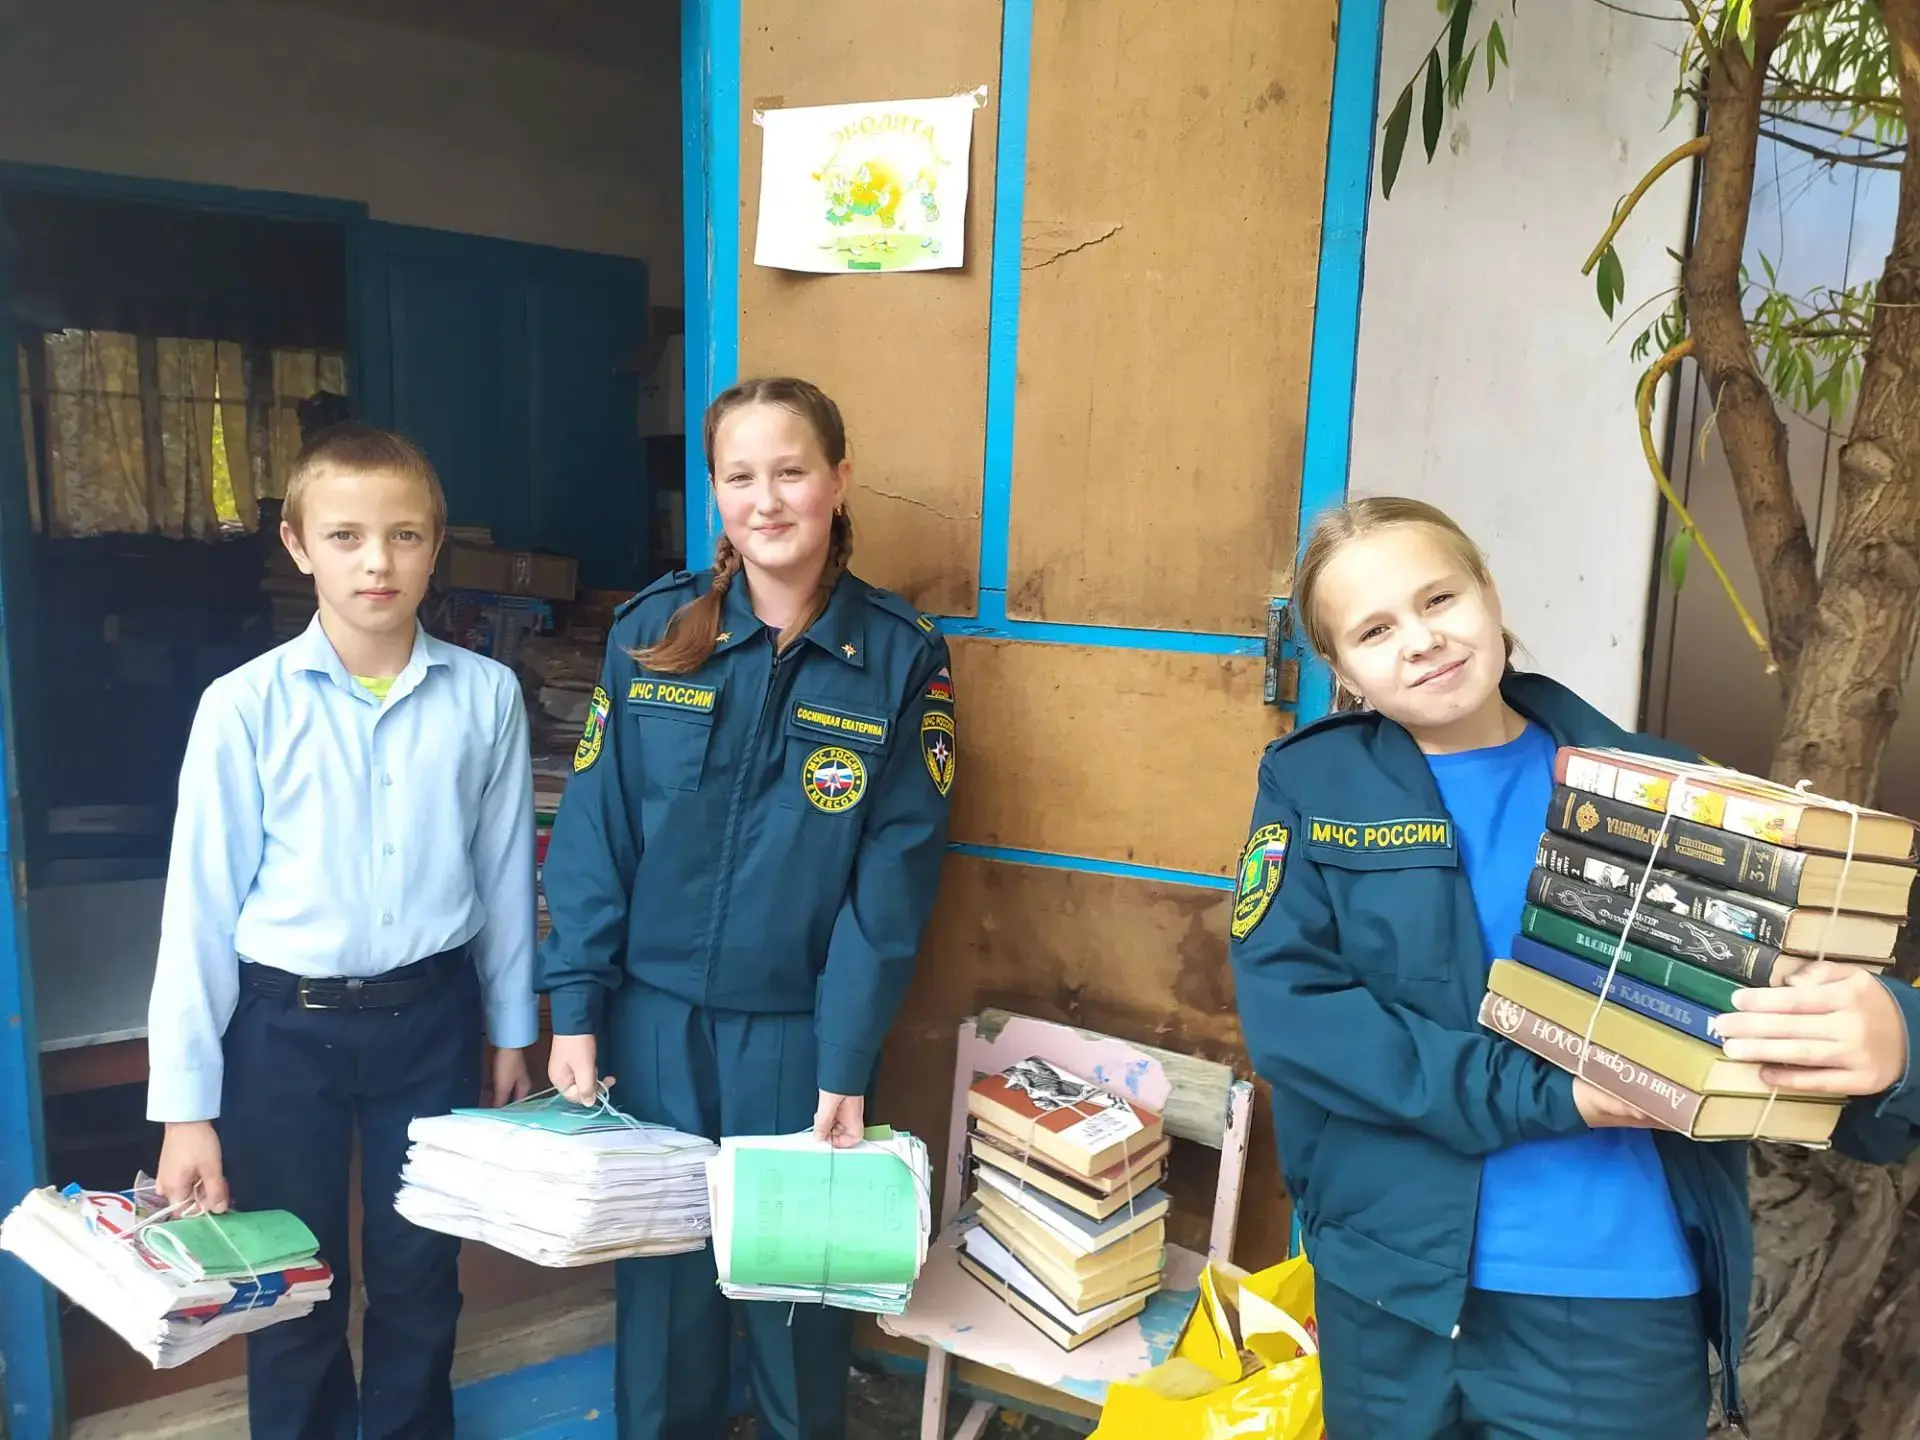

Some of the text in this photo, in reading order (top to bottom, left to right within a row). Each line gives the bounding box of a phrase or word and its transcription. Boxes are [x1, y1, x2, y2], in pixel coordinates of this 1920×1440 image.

[829, 112, 936, 143] ЭКОЛЯТА
[628, 682, 654, 700] МЧС
[656, 684, 713, 708] РОССИИ
[797, 707, 883, 737] СОСНИЦКАЯ ЕКАТЕРИНА
[808, 749, 862, 778] МЧС РОССИИ
[806, 784, 859, 809] EMERCOM
[1312, 823, 1445, 848] МЧС РОССИИ
[1592, 976, 1692, 1025] Лв КАССИЛЬ
[1593, 1049, 1636, 1083] Серж
[1636, 1072, 1649, 1084] и
[1650, 1078, 1688, 1110] Анн
